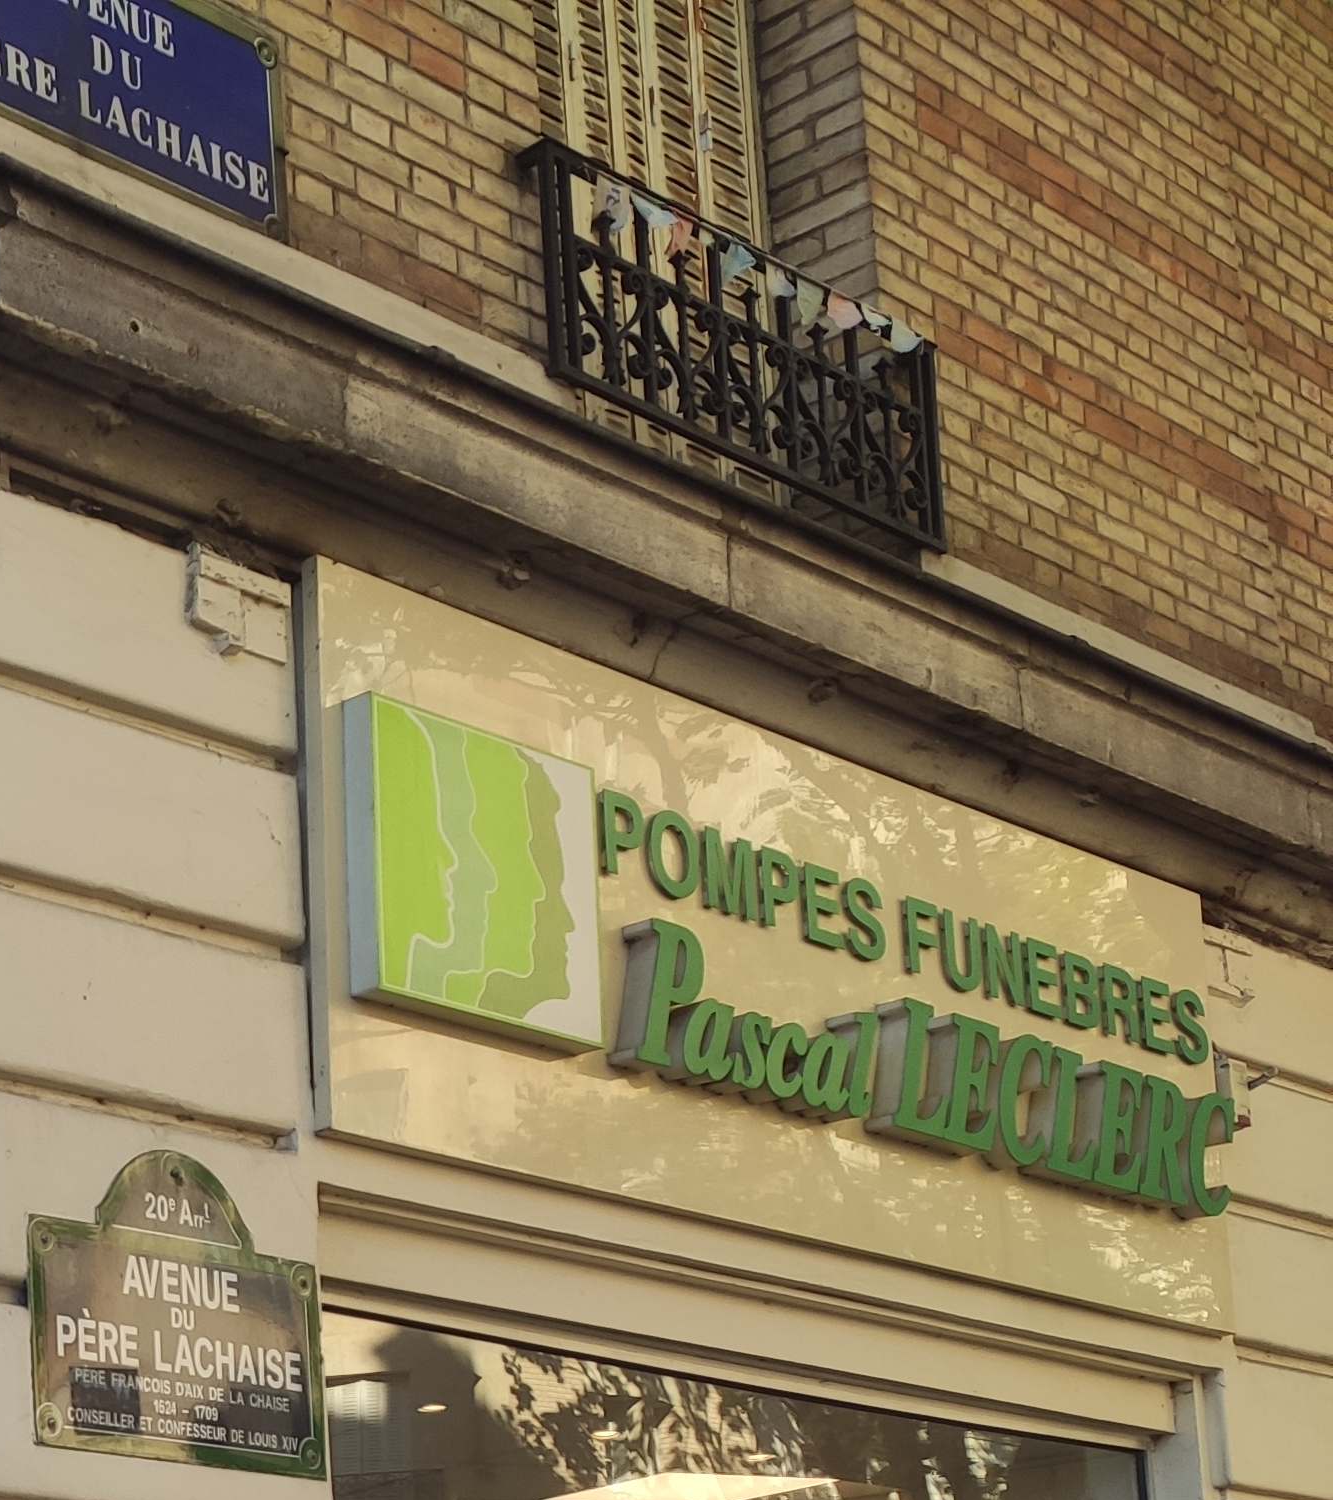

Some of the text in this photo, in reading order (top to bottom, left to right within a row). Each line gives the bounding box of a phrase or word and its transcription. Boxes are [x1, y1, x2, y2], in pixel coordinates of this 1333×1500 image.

[57, 0, 174, 58] ENUE
[91, 34, 141, 90] DU
[78, 79, 269, 203] LACHAISE
[598, 788, 1209, 1065] POMPES FUNEBRES
[609, 918, 1234, 1218] Pascal LECLERC
[122, 1254, 240, 1313] AVENUE
[170, 1307, 196, 1331] DU
[56, 1308, 303, 1393] PÈRE LACHAISE
[154, 1399, 177, 1416] 1624
[195, 1404, 219, 1422] 1709
[176, 1382, 204, 1400] D'AIX
[209, 1387, 225, 1403] DE
[229, 1388, 245, 1406] LA
[249, 1392, 290, 1413] CHAISE
[67, 1406, 299, 1452] CONSEILLER ET CONFESSEUR DE LOUIS XIV
